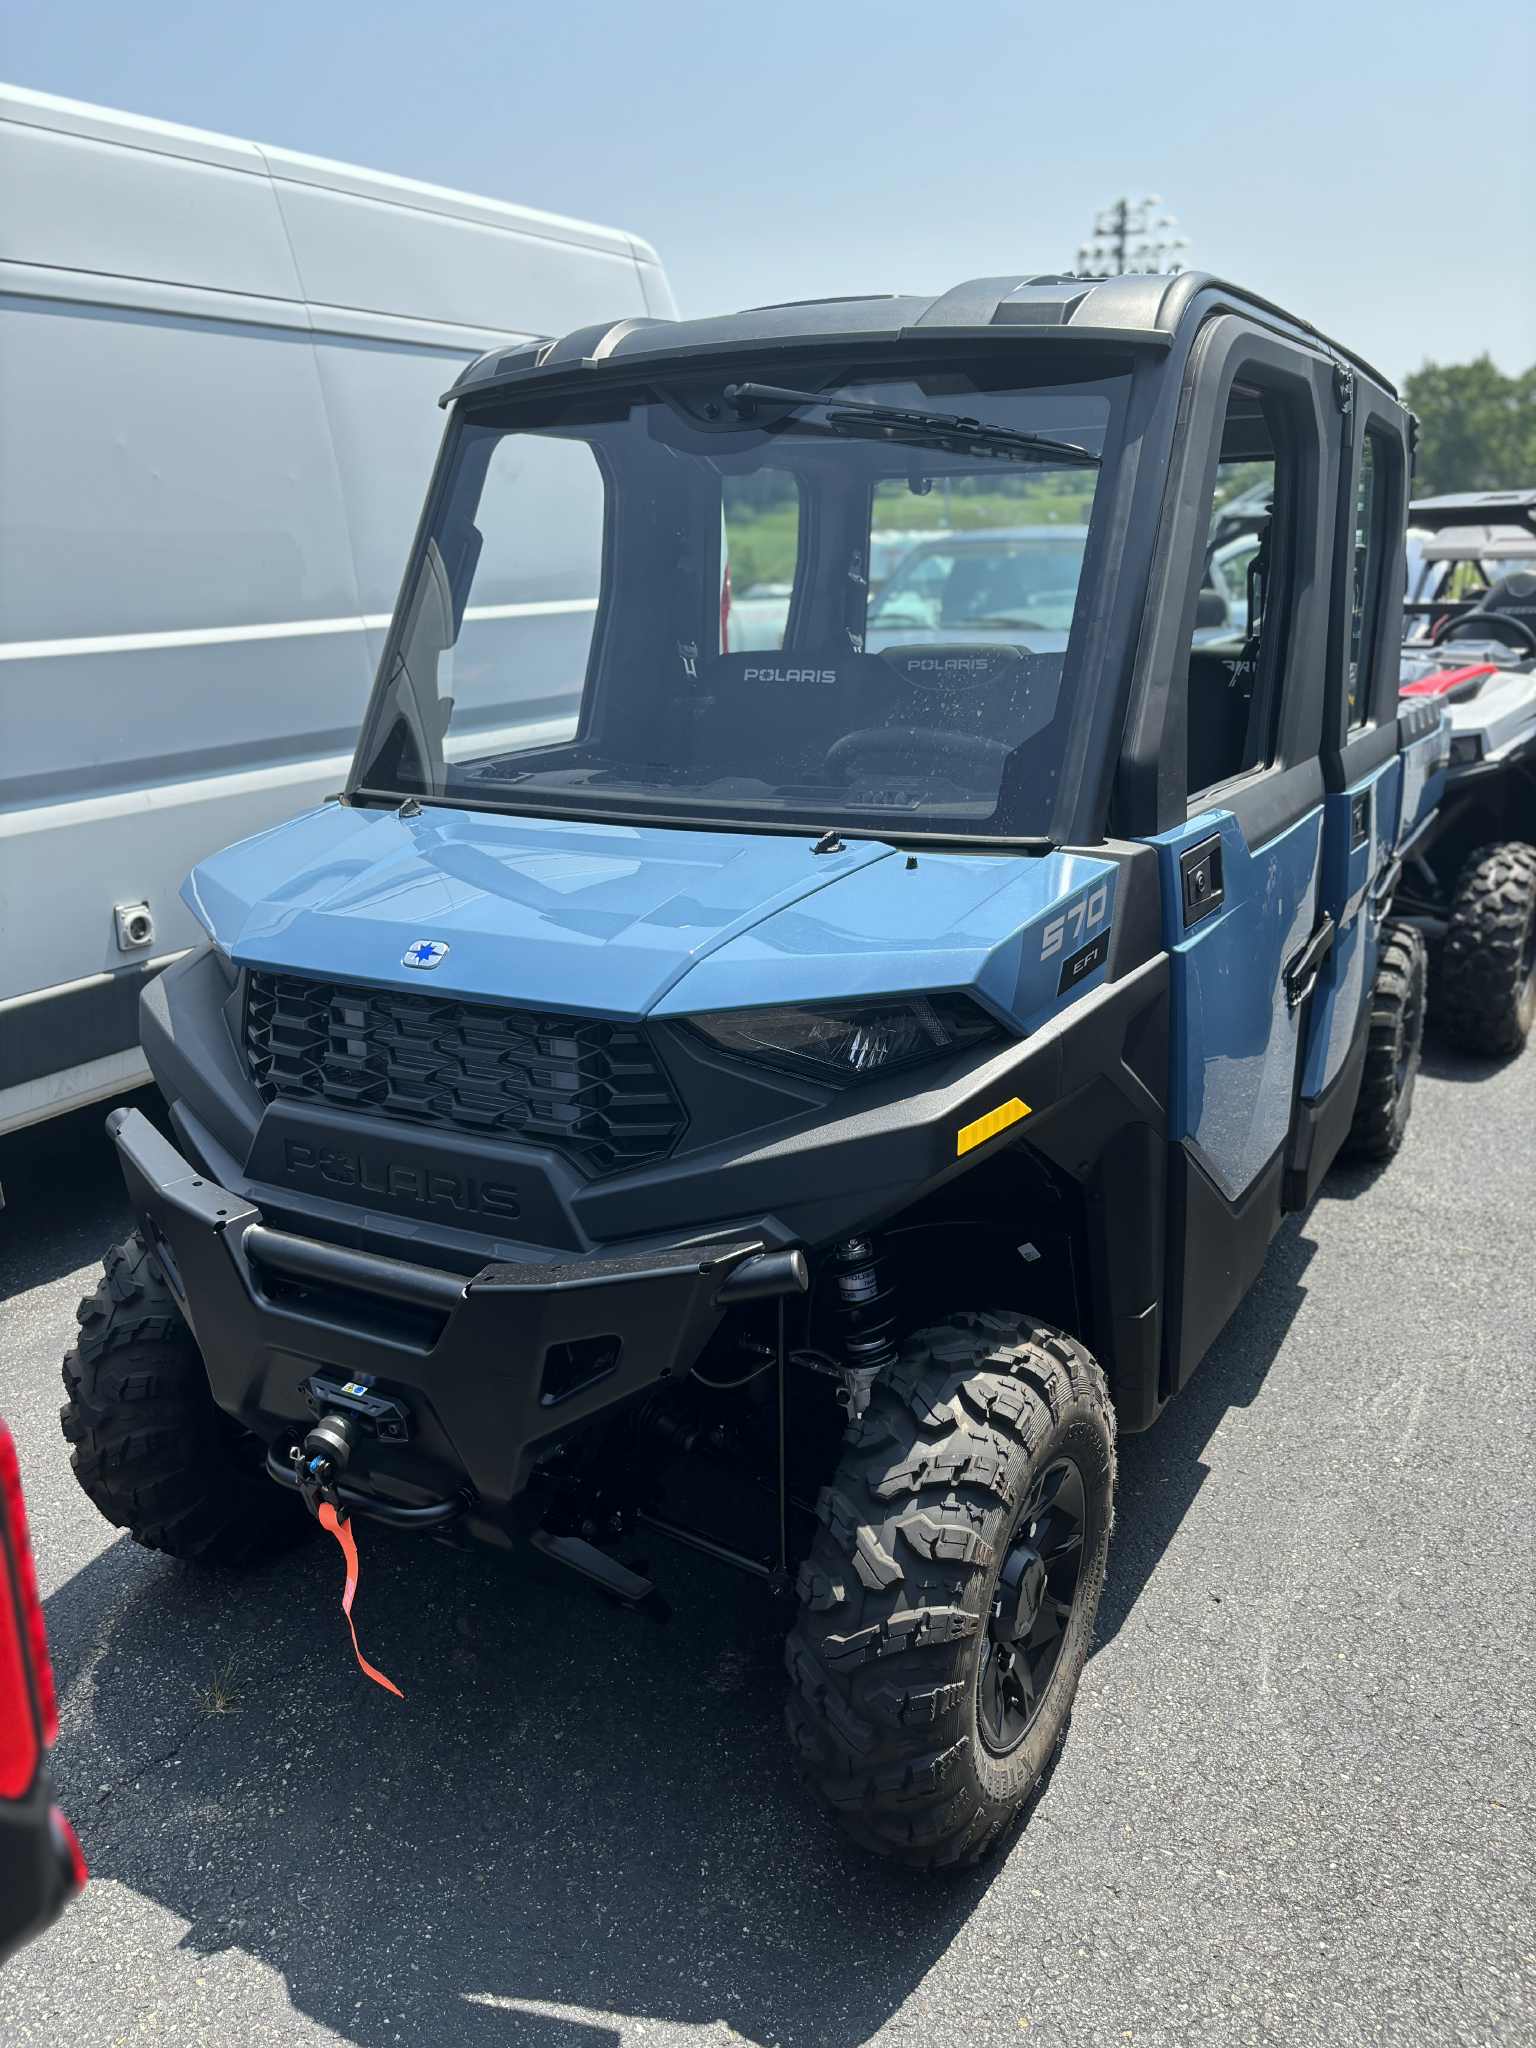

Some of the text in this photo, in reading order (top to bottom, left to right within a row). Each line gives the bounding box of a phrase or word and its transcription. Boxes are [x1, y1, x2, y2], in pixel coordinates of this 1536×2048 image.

[744, 669, 836, 683] POLARIS
[908, 659, 988, 671] POLARIS
[1040, 886, 1107, 961] 570
[1073, 948, 1098, 975] EFI
[284, 1138, 520, 1220] POLARIS
